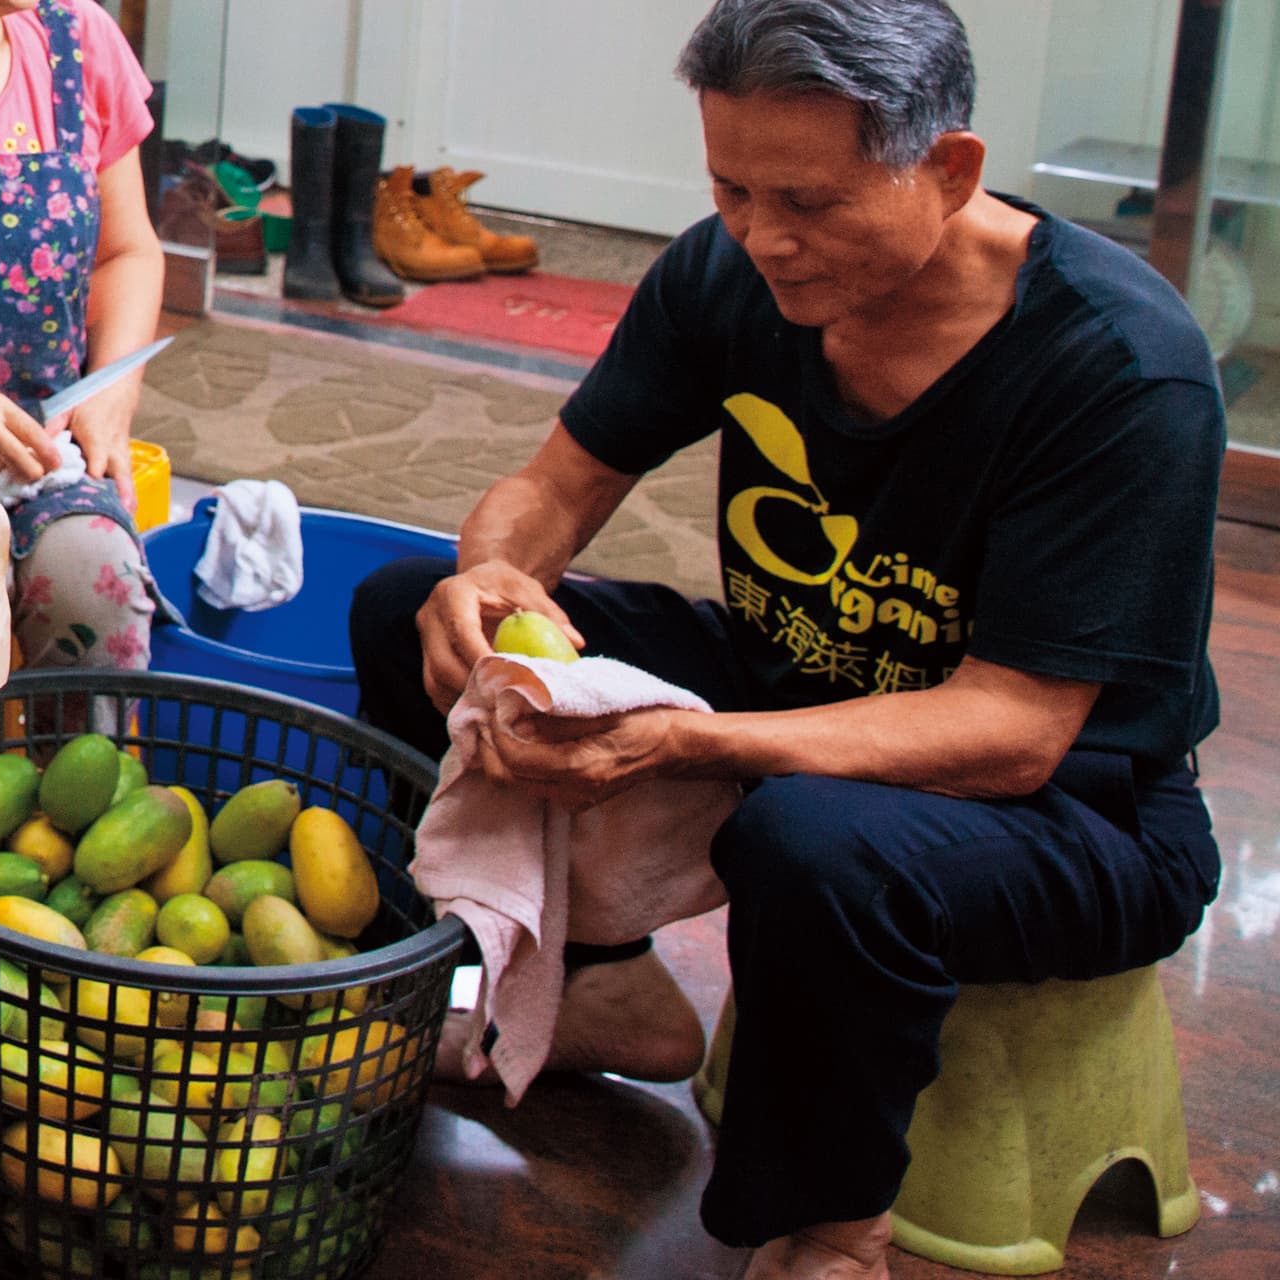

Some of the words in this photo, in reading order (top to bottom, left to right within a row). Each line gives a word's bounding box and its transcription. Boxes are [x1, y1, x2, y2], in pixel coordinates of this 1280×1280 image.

[727, 486, 973, 644] Organi
[844, 553, 959, 607] Lime
[726, 567, 956, 696] 東海萊姆
